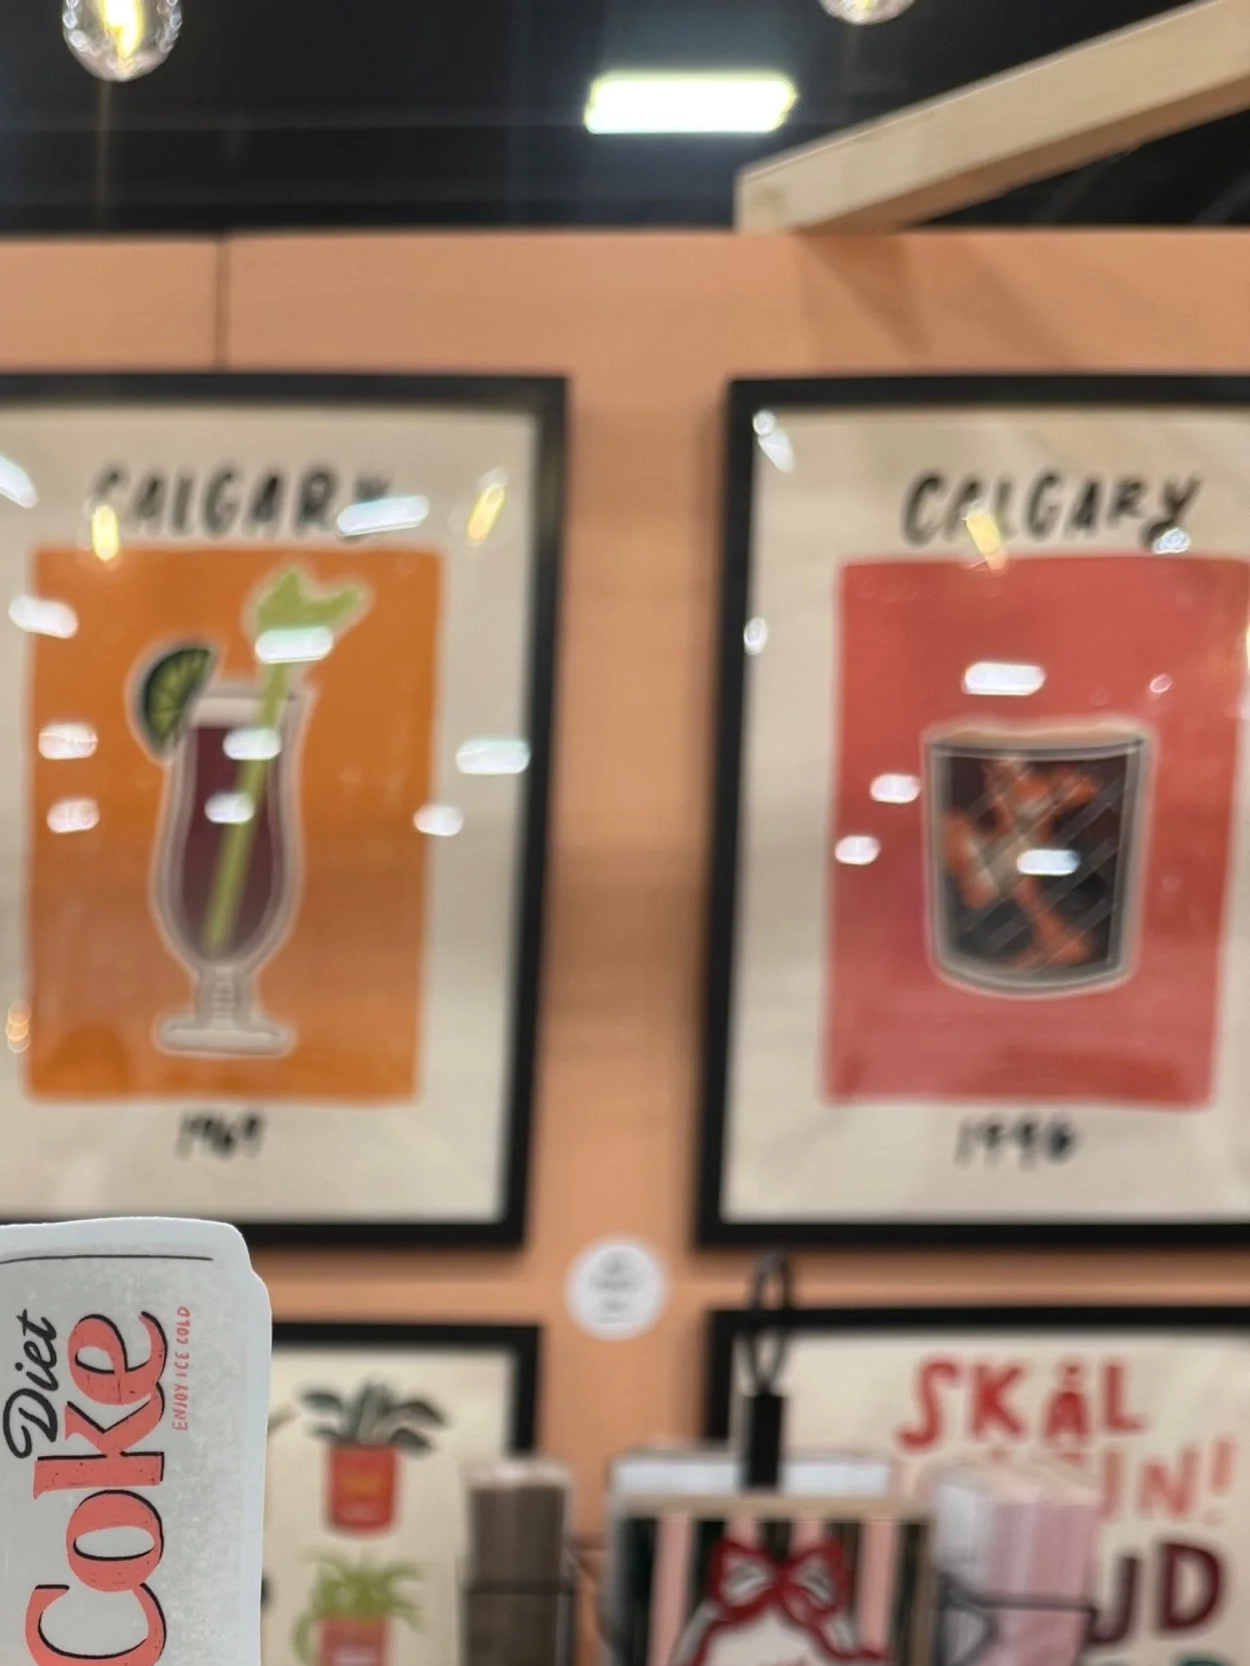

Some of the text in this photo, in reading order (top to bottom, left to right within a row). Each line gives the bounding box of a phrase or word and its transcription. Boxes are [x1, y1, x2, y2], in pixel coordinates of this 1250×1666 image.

[2, 1308, 59, 1459] Diet
[172, 1306, 192, 1431] ENJOY ICE COLD
